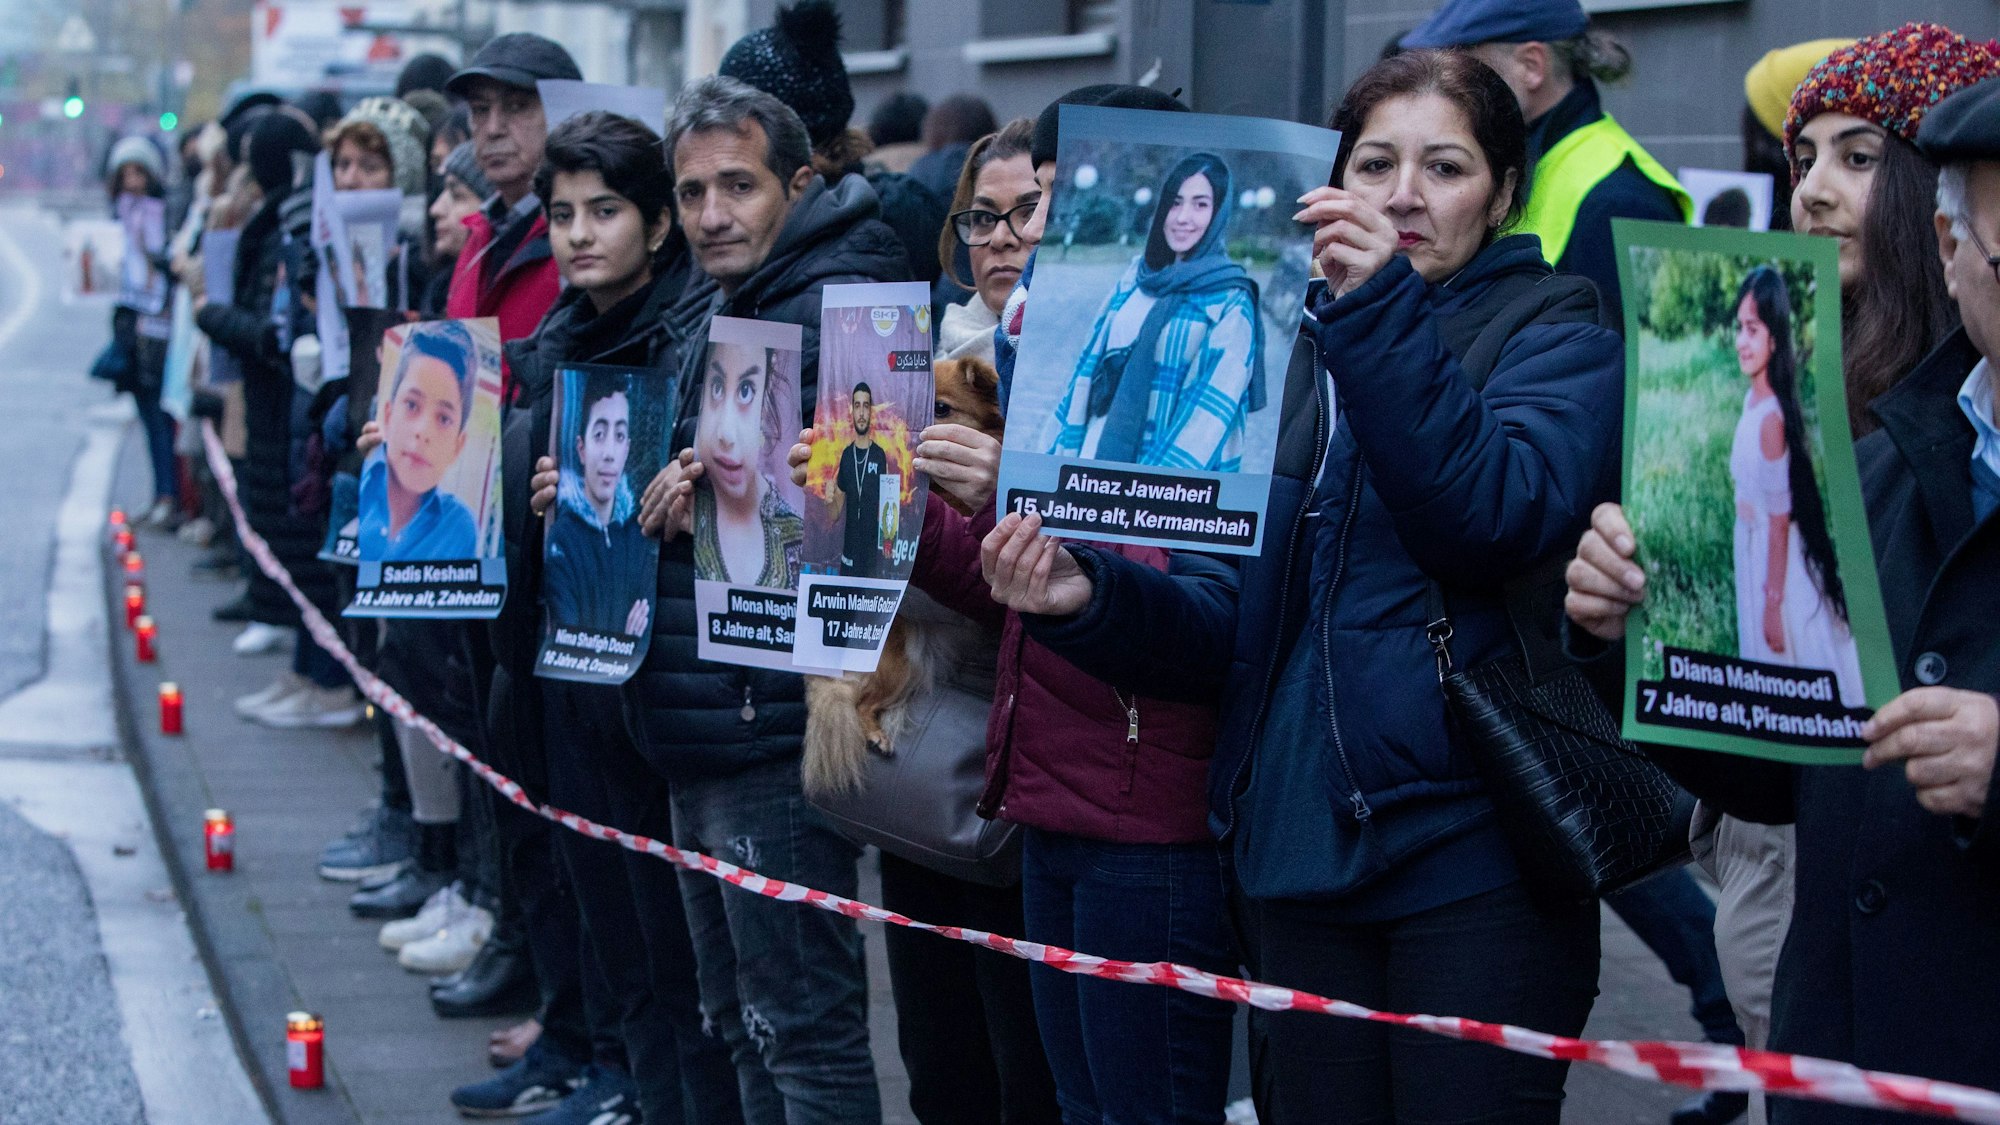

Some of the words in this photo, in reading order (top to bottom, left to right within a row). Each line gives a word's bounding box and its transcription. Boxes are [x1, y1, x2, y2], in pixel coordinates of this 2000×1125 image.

[873, 310, 897, 320] SKF
[1065, 473, 1120, 496] Ainaz
[1124, 479, 1212, 504] Jawaheri
[1013, 497, 1037, 515] 15
[1040, 500, 1098, 522] Jahre
[1100, 507, 1130, 529] alt,
[1133, 509, 1250, 537] Kermanshah
[384, 566, 422, 583] Sadis
[423, 564, 478, 582] Keshani
[354, 591, 373, 606] 14
[373, 591, 412, 606] Jahre
[414, 592, 436, 608] alt,
[437, 590, 499, 606] Zahedan
[731, 595, 763, 614] Mona
[812, 591, 846, 610] Arwin
[712, 619, 720, 635] 8
[722, 620, 755, 640] Jahre
[756, 625, 774, 644] alt,
[827, 620, 840, 637] 17
[842, 621, 863, 638] Jahre
[608, 637, 635, 656] Doost
[553, 652, 578, 668] Jahre
[1670, 655, 1725, 686] Diana
[1726, 664, 1834, 701] Mahmoodi
[1642, 688, 1658, 713] 7
[1660, 692, 1718, 722] Jahre
[1720, 701, 1750, 730] alt,
[1751, 704, 1865, 738] Piranshah
